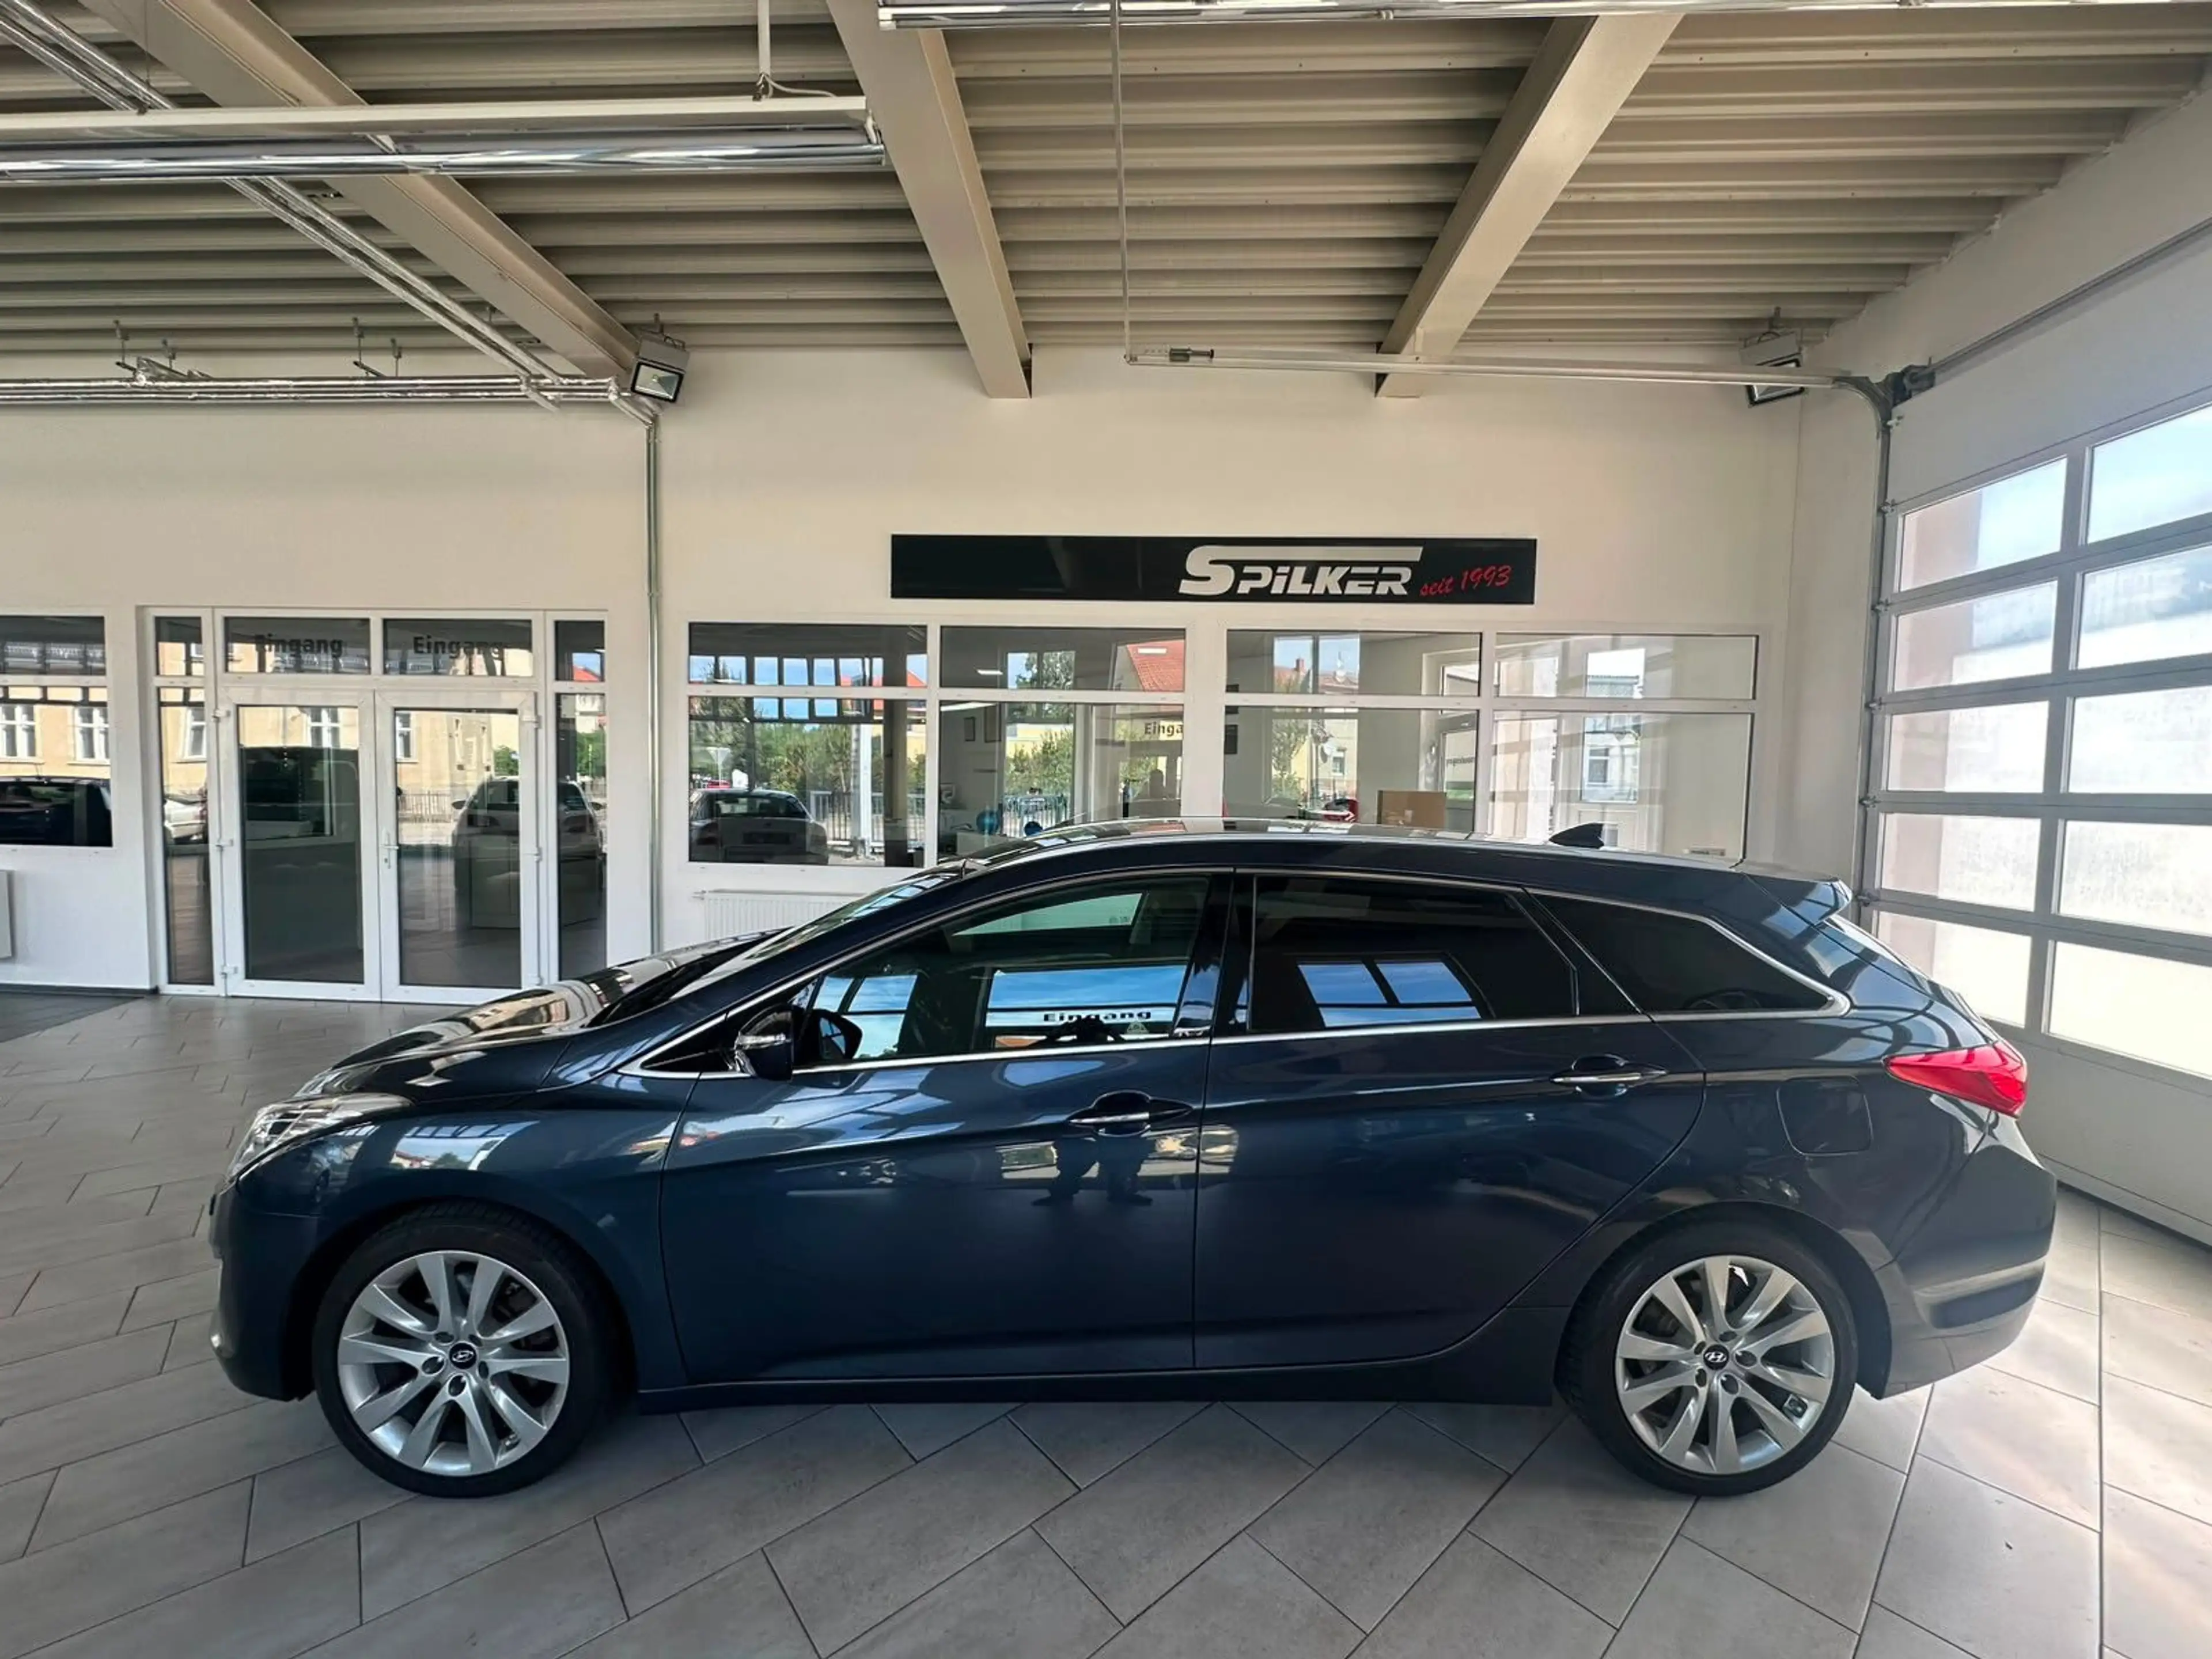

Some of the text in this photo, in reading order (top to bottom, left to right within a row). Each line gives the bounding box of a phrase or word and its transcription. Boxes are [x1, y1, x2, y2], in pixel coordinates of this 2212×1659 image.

[1419, 575, 1454, 596] seit
[1460, 564, 1512, 592] 1993
[255, 632, 343, 658] Eingang
[413, 634, 503, 659] Eingang
